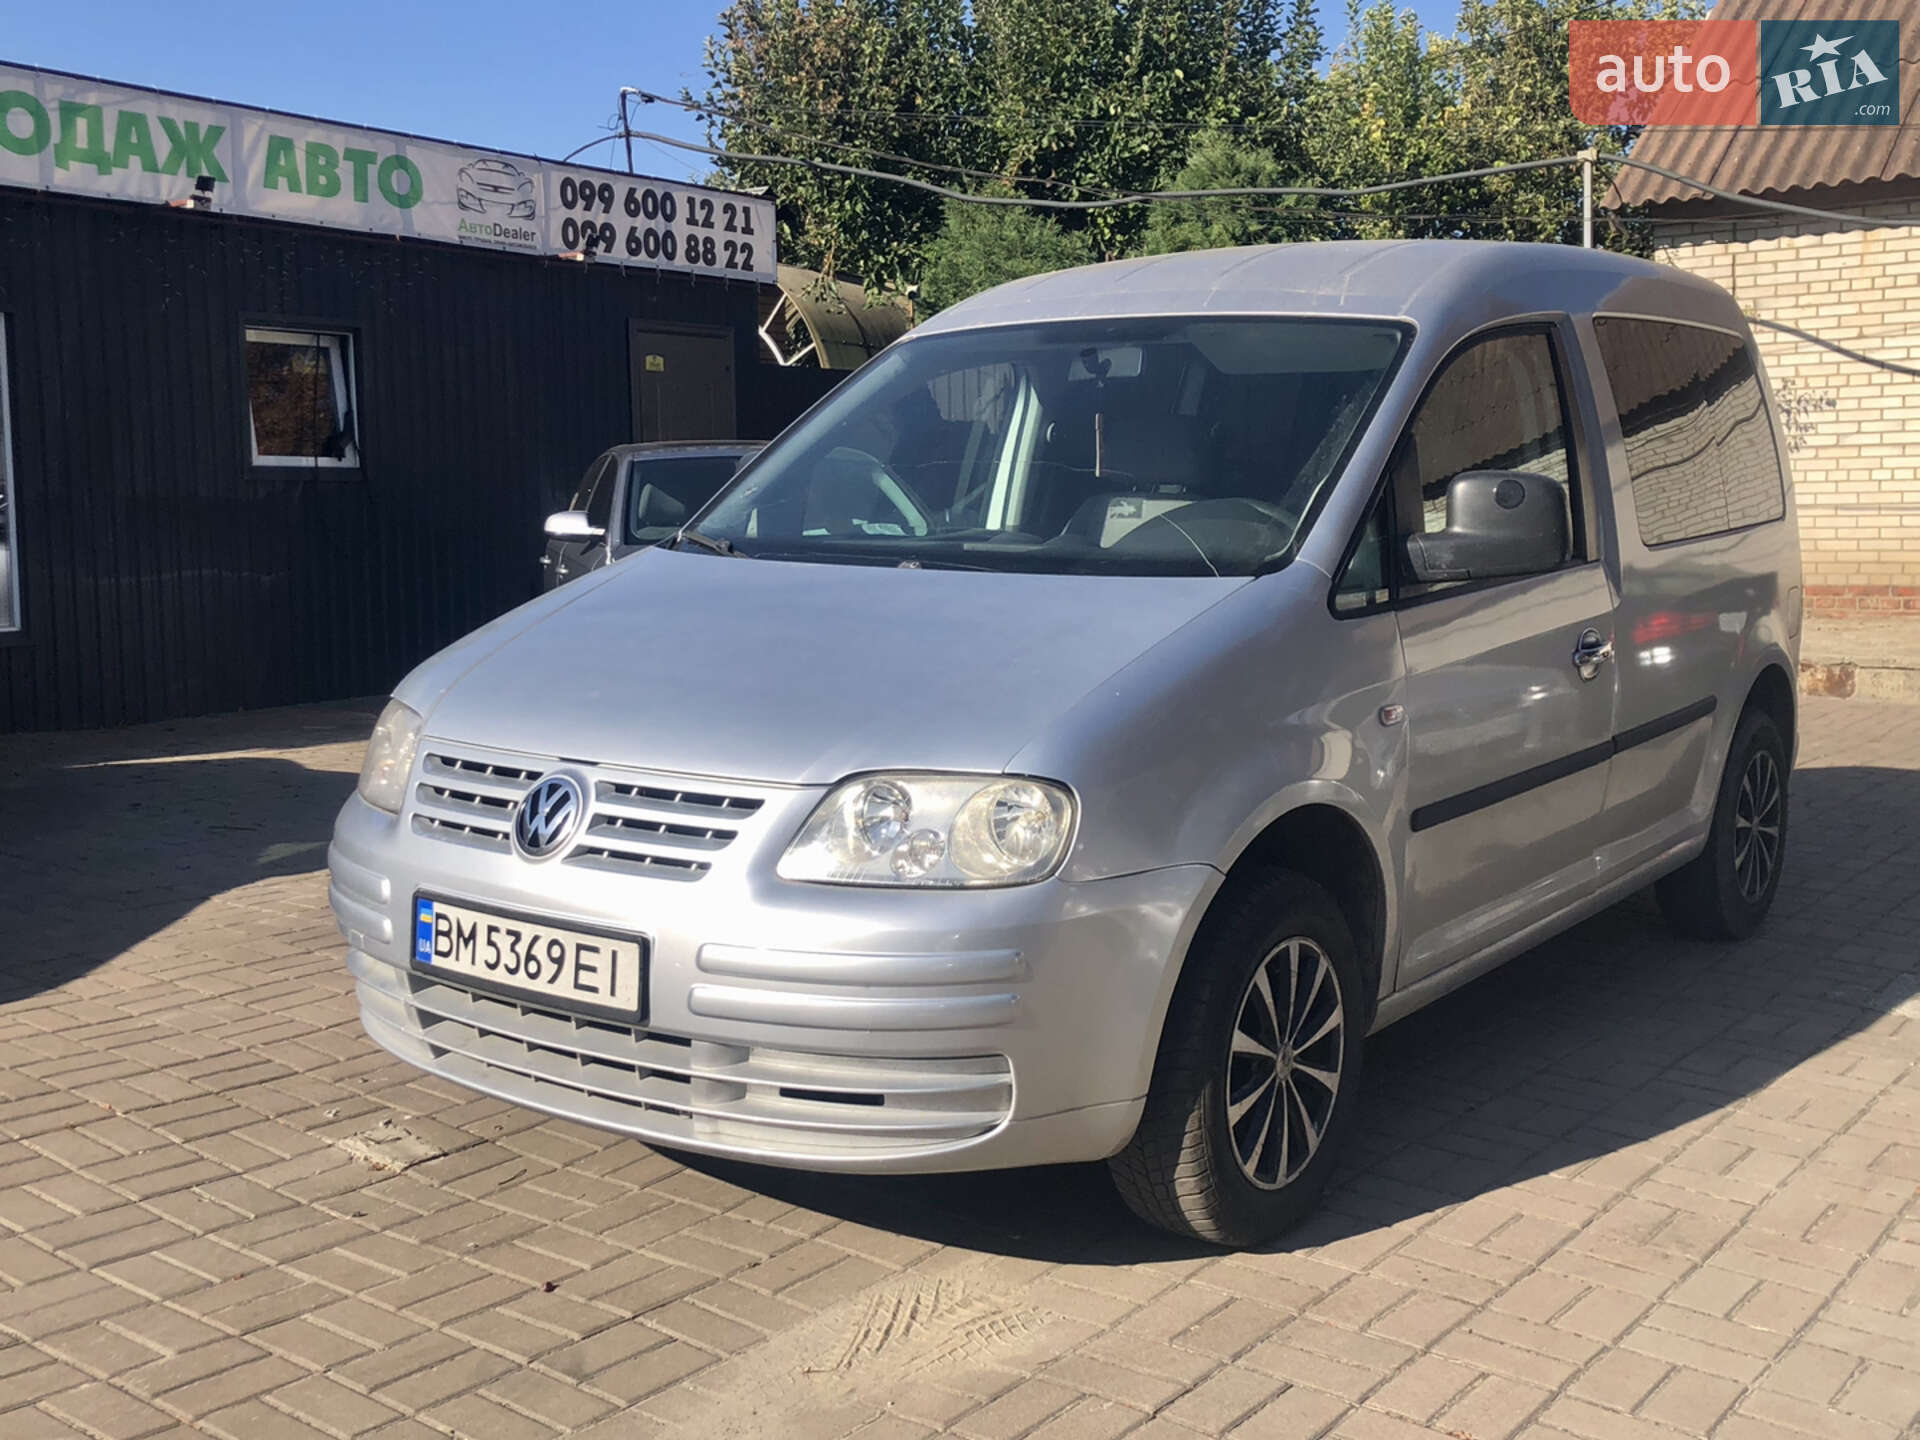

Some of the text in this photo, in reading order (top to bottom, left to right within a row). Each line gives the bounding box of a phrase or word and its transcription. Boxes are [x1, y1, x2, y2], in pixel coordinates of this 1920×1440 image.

[264, 135, 423, 209] АВТО
[560, 176, 755, 236] 099 600 12 21
[626, 226, 678, 261] 600
[685, 233, 717, 266] 88
[724, 240, 754, 272] 22
[418, 937, 432, 955] UA
